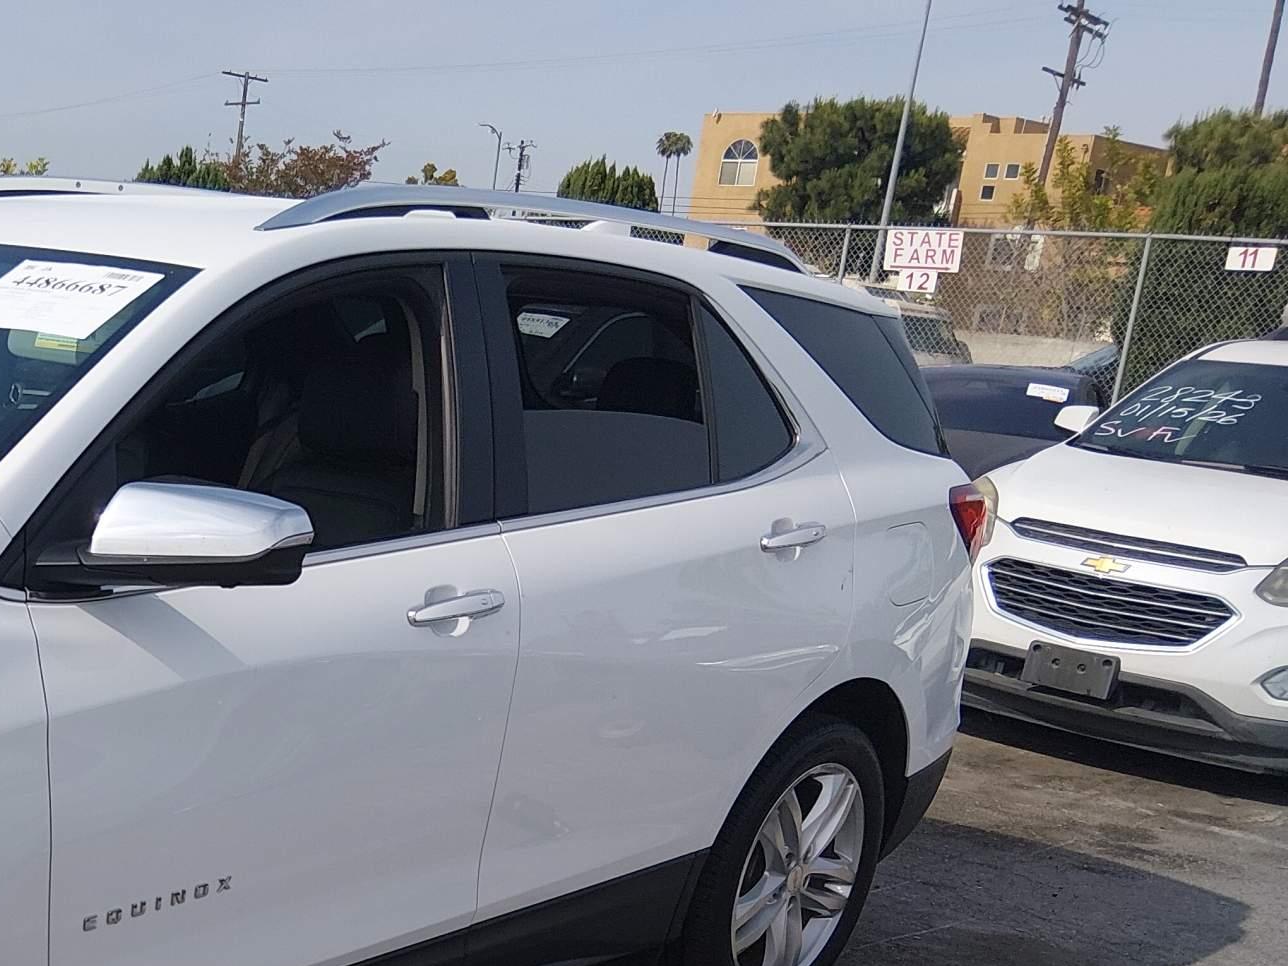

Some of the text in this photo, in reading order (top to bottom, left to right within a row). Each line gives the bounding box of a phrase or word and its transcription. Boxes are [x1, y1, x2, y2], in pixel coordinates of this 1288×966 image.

[892, 231, 961, 249] STATE
[892, 247, 955, 265] FARM
[1238, 248, 1259, 269] 11
[12, 275, 129, 297] 44866687
[905, 271, 930, 291] 12
[1140, 386, 1263, 410] 28243
[1119, 403, 1246, 425] 01/15/26
[82, 876, 233, 932] EQUINOX
